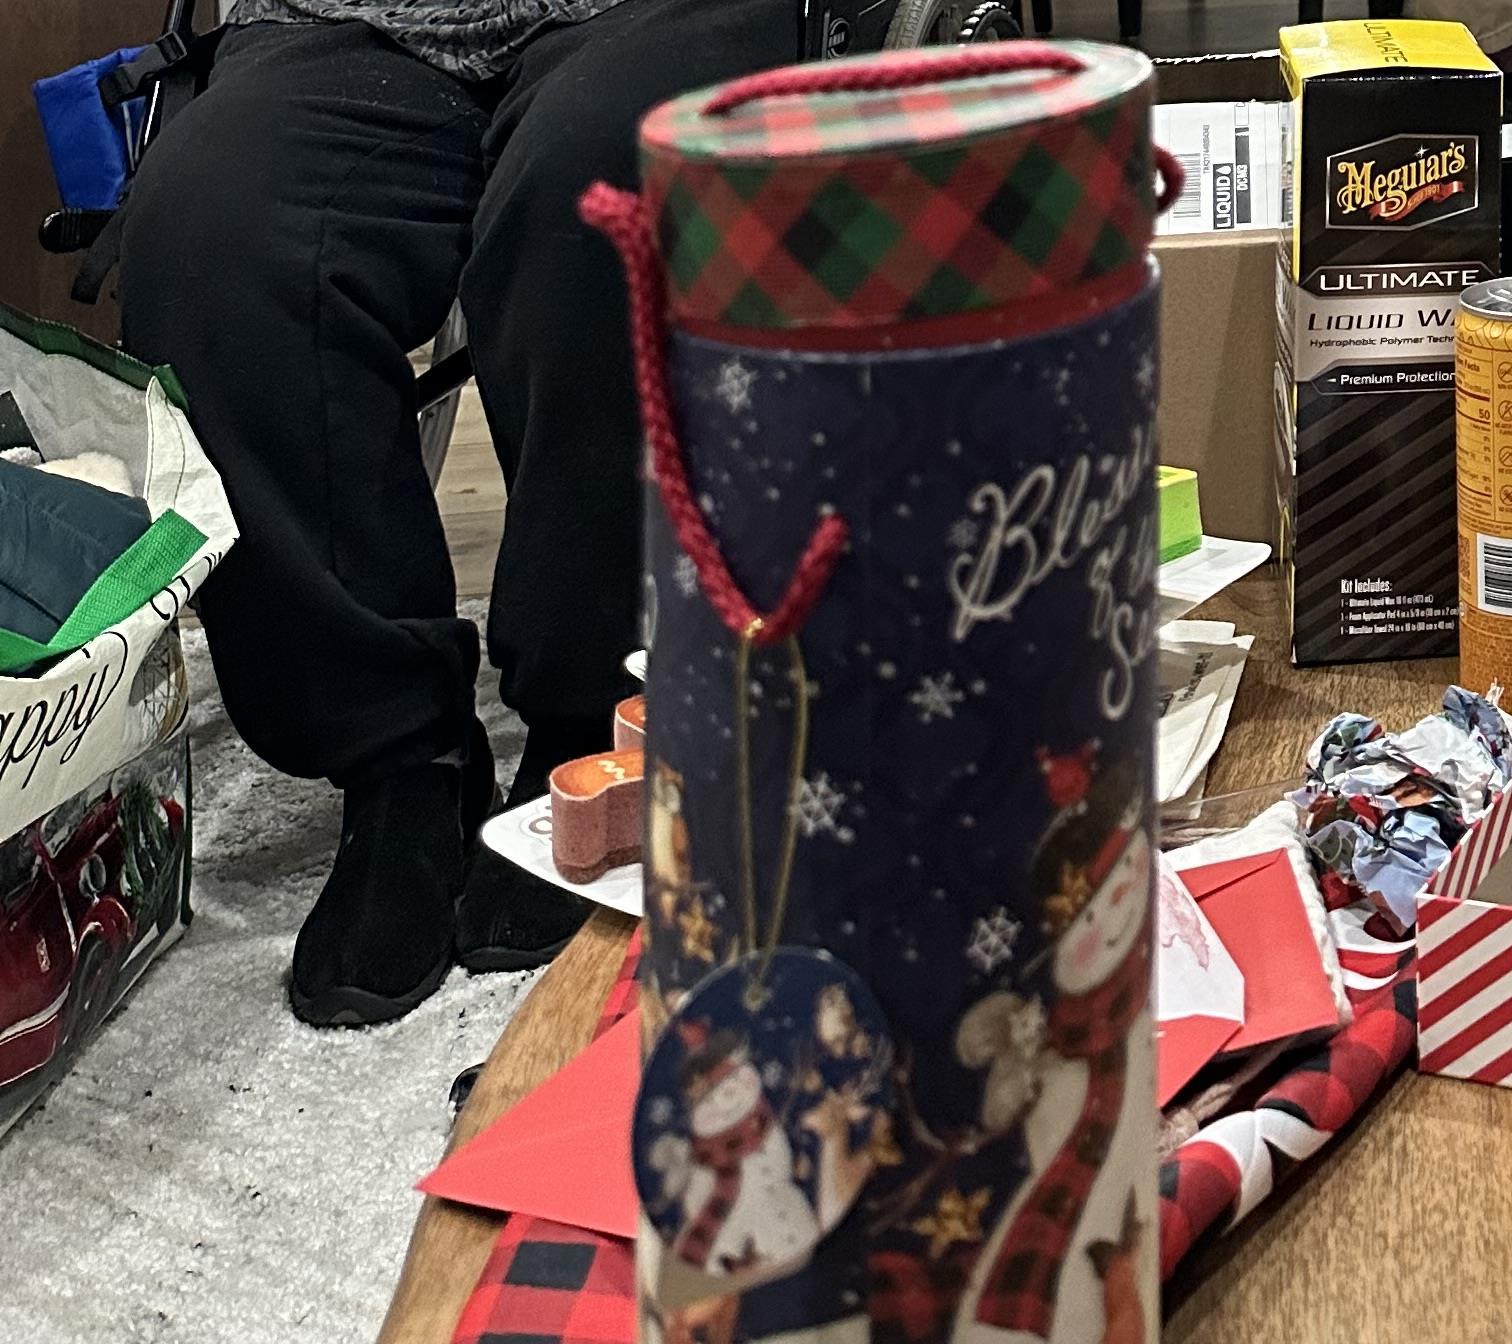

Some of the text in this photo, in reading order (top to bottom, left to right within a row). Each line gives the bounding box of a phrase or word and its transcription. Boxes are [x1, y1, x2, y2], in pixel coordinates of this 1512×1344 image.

[1336, 141, 1466, 218] Meguiar's
[1216, 176, 1232, 228] LIQUID
[1319, 269, 1480, 291] ULTIMATE
[1307, 308, 1455, 331] LIQUID W
[1310, 337, 1377, 348] Hydrophobic
[1379, 335, 1425, 346] Polymer
[1340, 373, 1394, 385] Premium
[1478, 408, 1491, 420] 50
[1340, 577, 1393, 593] Kit Includes:
[0, 664, 109, 789] ppy
